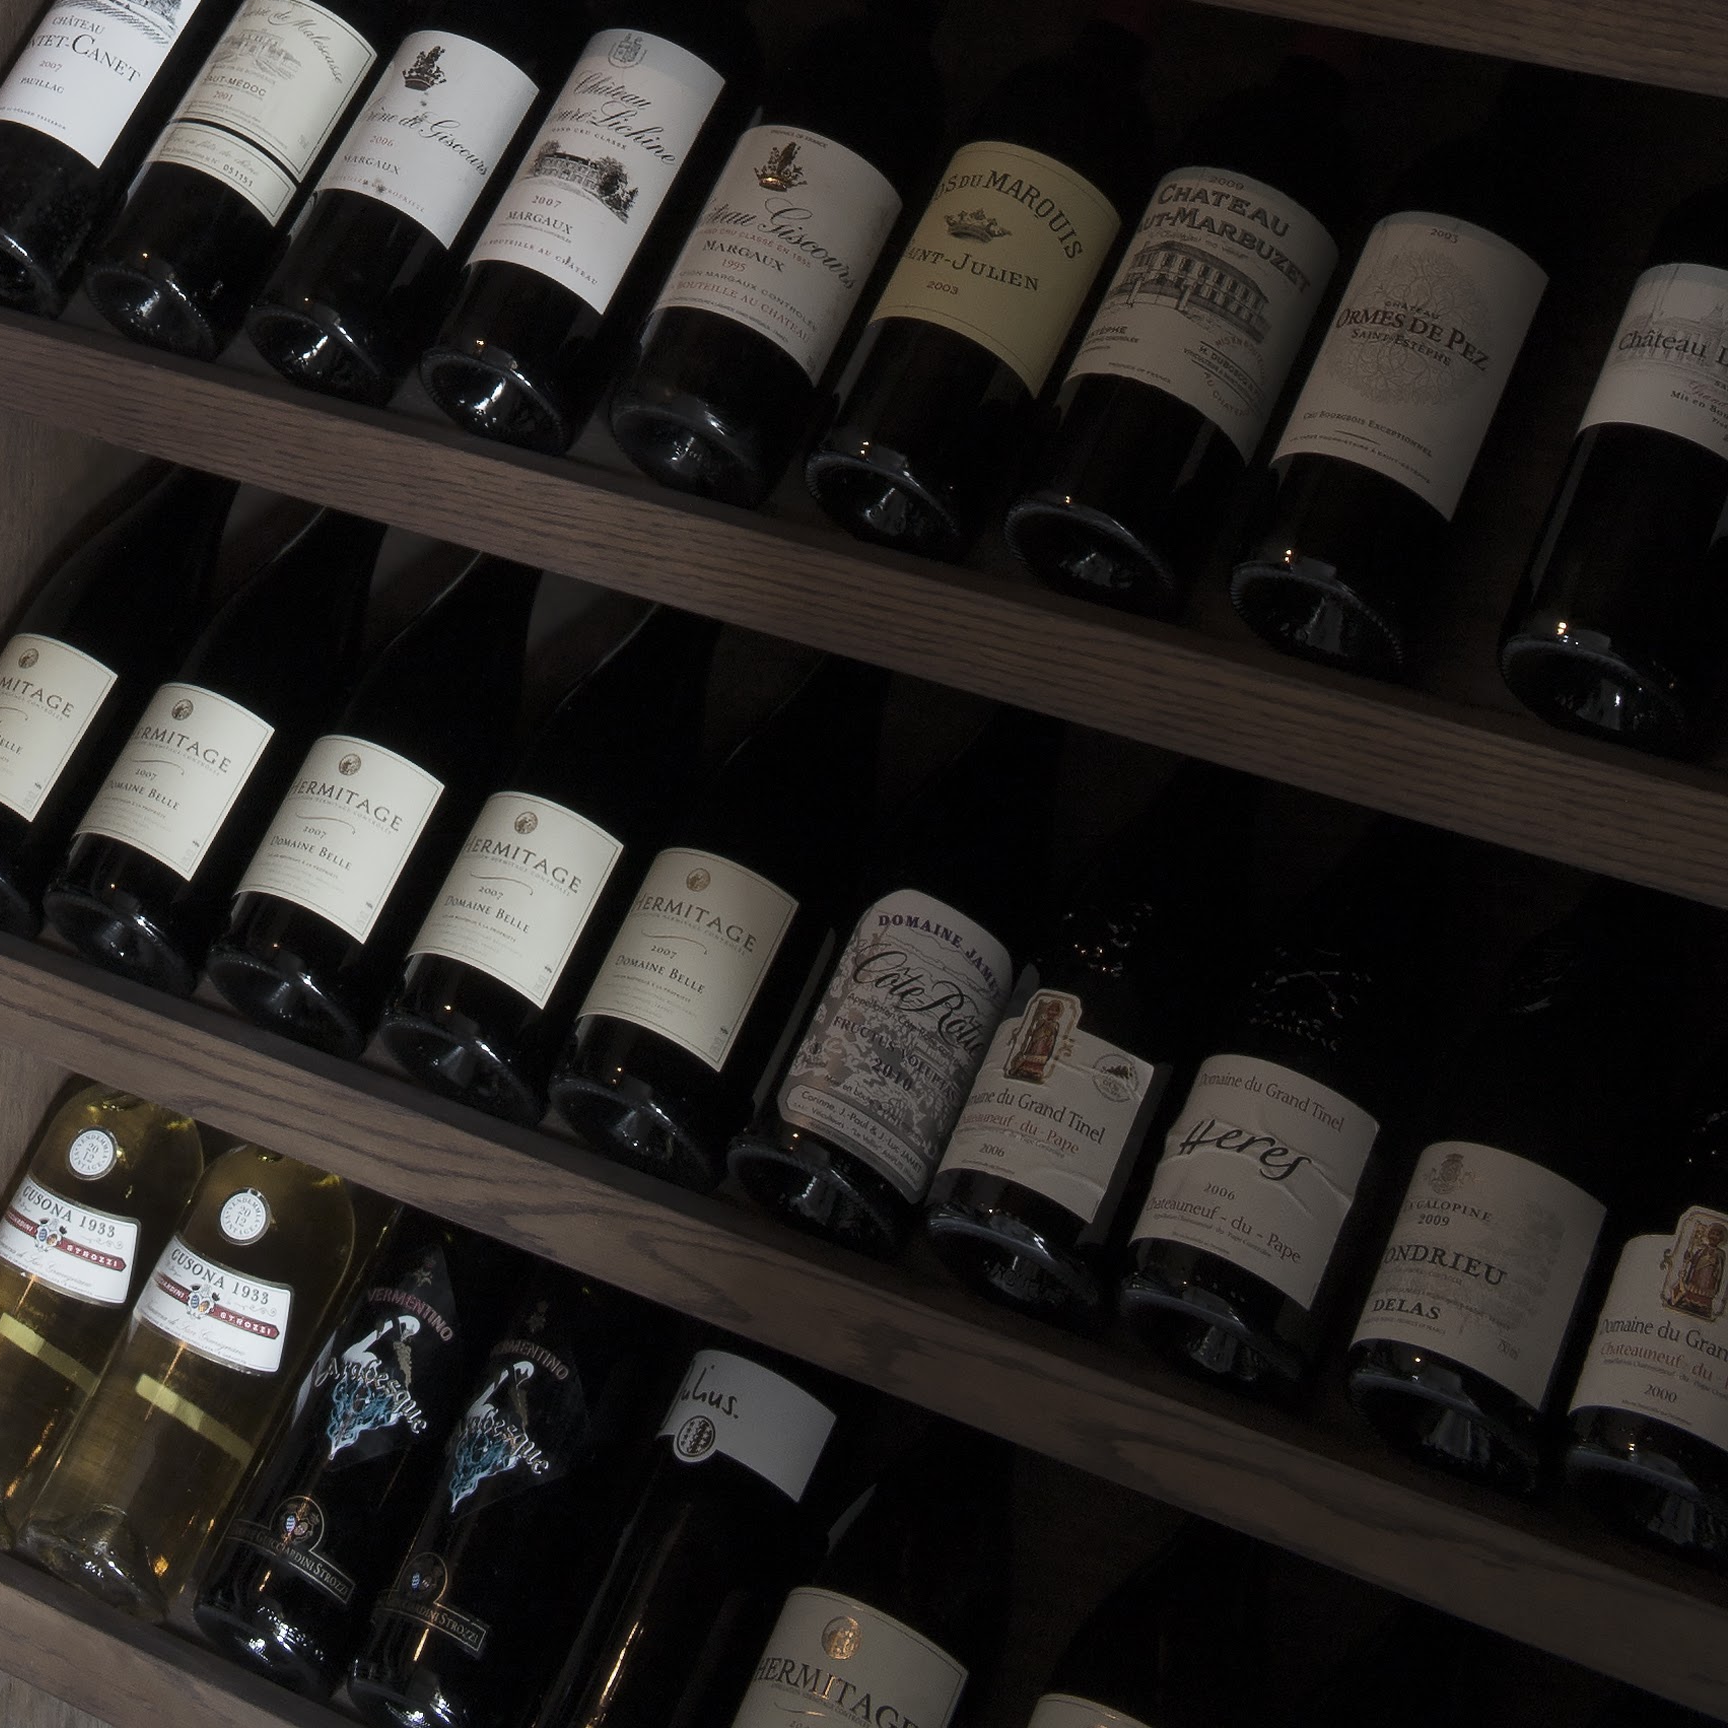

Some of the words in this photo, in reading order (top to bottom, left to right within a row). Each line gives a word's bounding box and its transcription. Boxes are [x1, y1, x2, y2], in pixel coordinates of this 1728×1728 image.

[20, 76, 65, 94] PAUILLAC
[531, 195, 562, 208] 2007
[506, 210, 573, 235] MARGAUX
[987, 169, 1084, 260] MARQUIS
[702, 239, 787, 274] MARGAUX
[721, 258, 747, 272] 1995
[926, 280, 959, 295] 2003
[1409, 318, 1442, 343] DE
[1447, 328, 1490, 371] PEZ
[1617, 331, 1708, 357] Château
[319, 846, 353, 871] BELLE
[478, 884, 504, 901] 2007
[878, 913, 962, 947] DOMAINE
[650, 945, 677, 960] 2007
[667, 967, 706, 995] BELLE
[1265, 1082, 1308, 1113] Grand
[1180, 1117, 1312, 1181] Heres
[1203, 1181, 1237, 1200] 2006
[79, 1214, 117, 1239] 1933
[1417, 1214, 1450, 1229] 2009
[232, 1280, 270, 1306] 1933
[1372, 1296, 1441, 1321] DELAS
[1643, 1382, 1679, 1403] 2000
